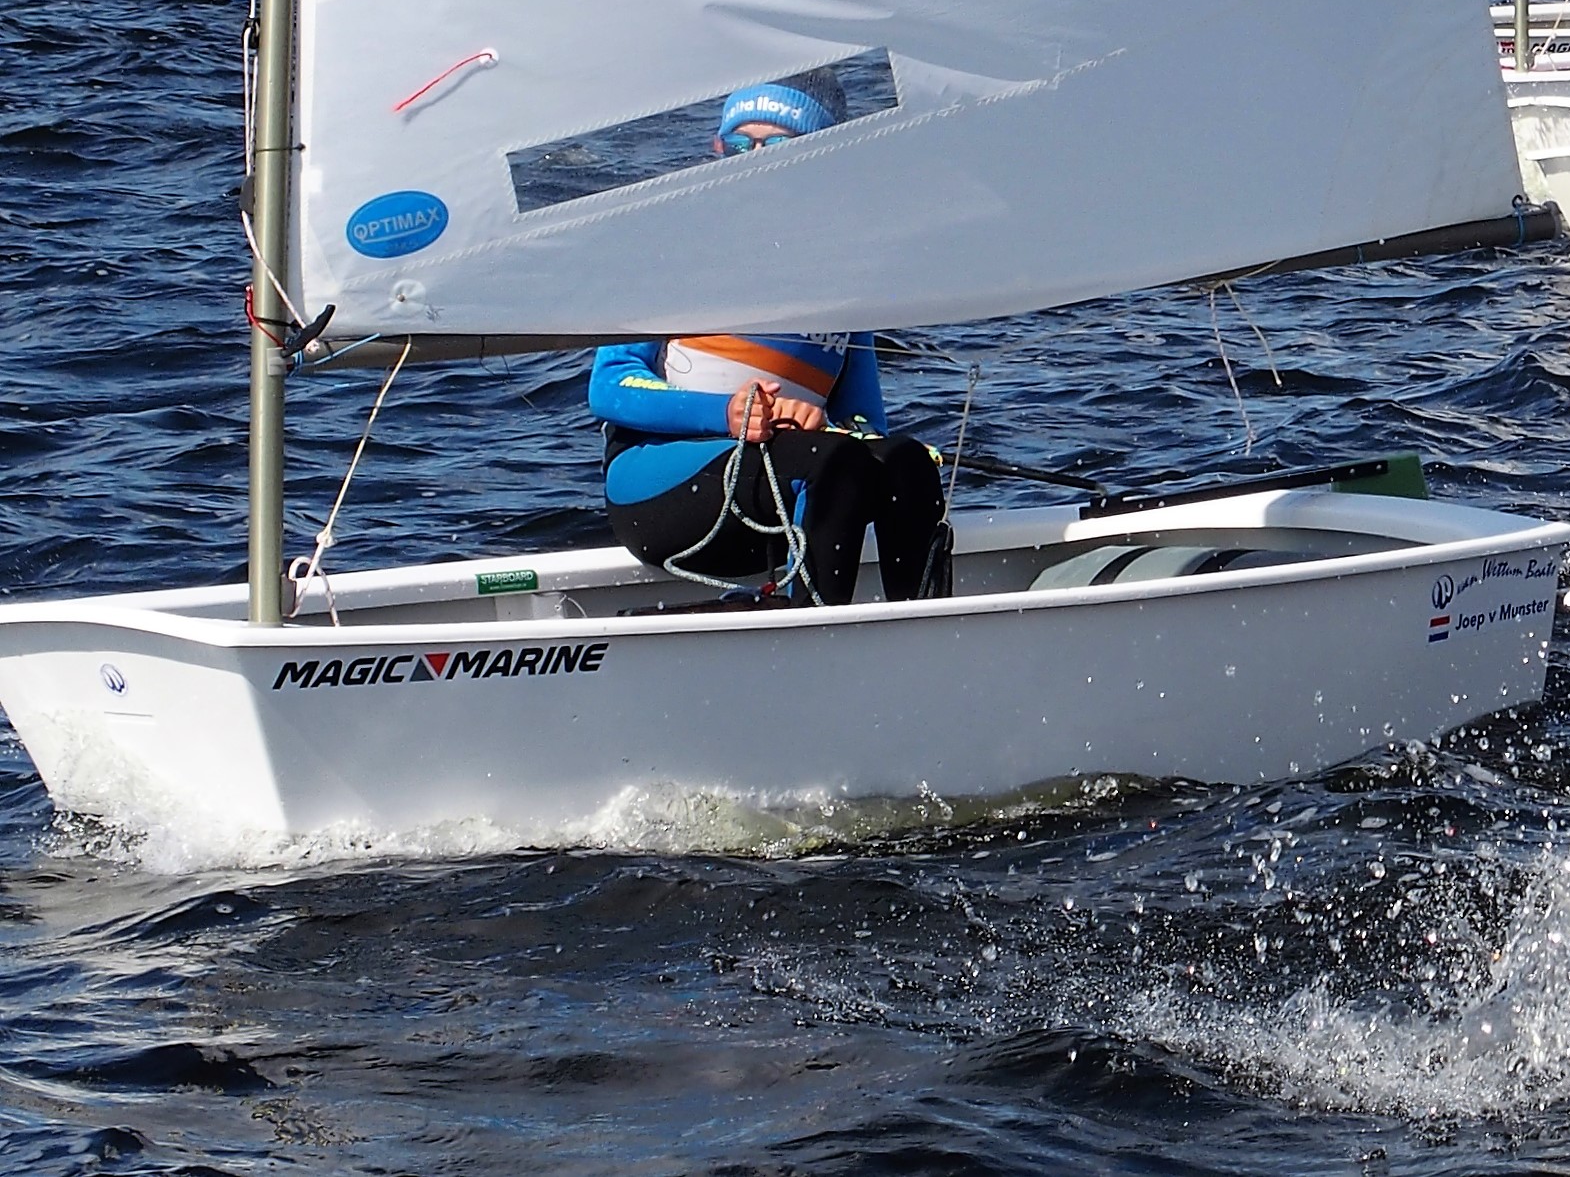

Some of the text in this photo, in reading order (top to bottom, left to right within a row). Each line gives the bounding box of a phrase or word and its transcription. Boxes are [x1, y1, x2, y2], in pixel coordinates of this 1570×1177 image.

[756, 96, 802, 119] lloyd
[354, 206, 441, 243] OPTIMAX
[480, 571, 534, 585] STARBOARD
[1455, 600, 1549, 630] Joep v Munster
[272, 643, 609, 690] MAGIC MARINE
